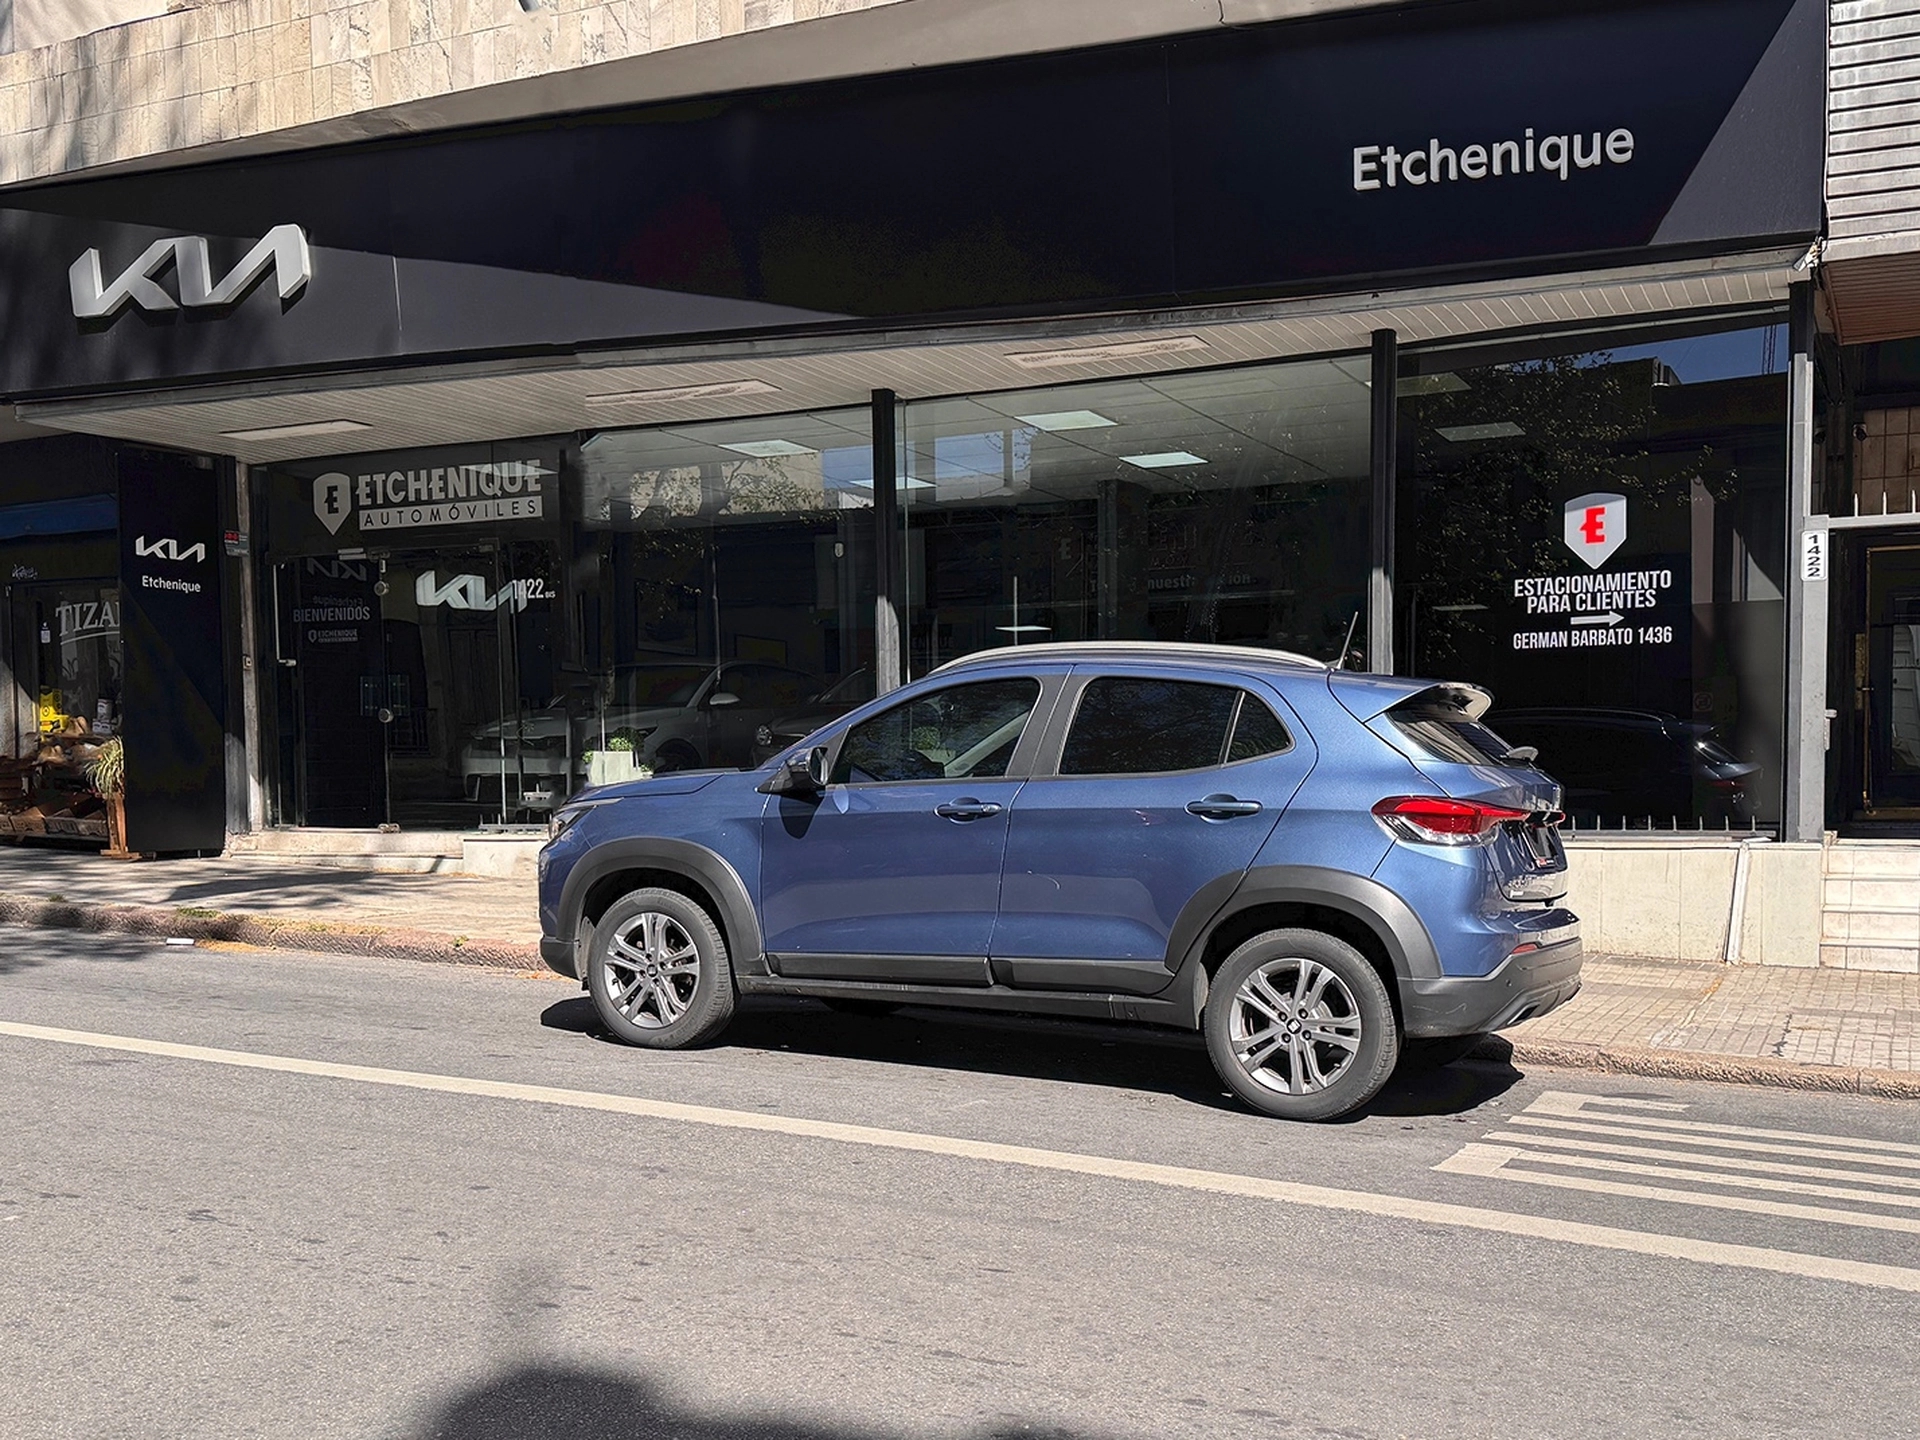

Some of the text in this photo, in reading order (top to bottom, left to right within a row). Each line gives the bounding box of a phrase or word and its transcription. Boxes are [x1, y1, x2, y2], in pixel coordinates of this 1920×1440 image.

[1353, 127, 1634, 190] Etchenique
[69, 223, 311, 317] KIA
[356, 459, 542, 507] ETCHENIQUE
[363, 499, 537, 527] AUTOMÓVILES
[135, 534, 205, 563] KIA
[1807, 534, 1821, 577] 1422
[142, 575, 201, 594] Etchenique
[415, 570, 527, 614] KIA
[1514, 570, 1672, 597] ESTACIONAMIENTO
[292, 606, 371, 622] BIENVENIDOS
[1527, 589, 1656, 614] PARA CLIENTES
[1513, 625, 1673, 650] GERMAN BARBATO 1436
